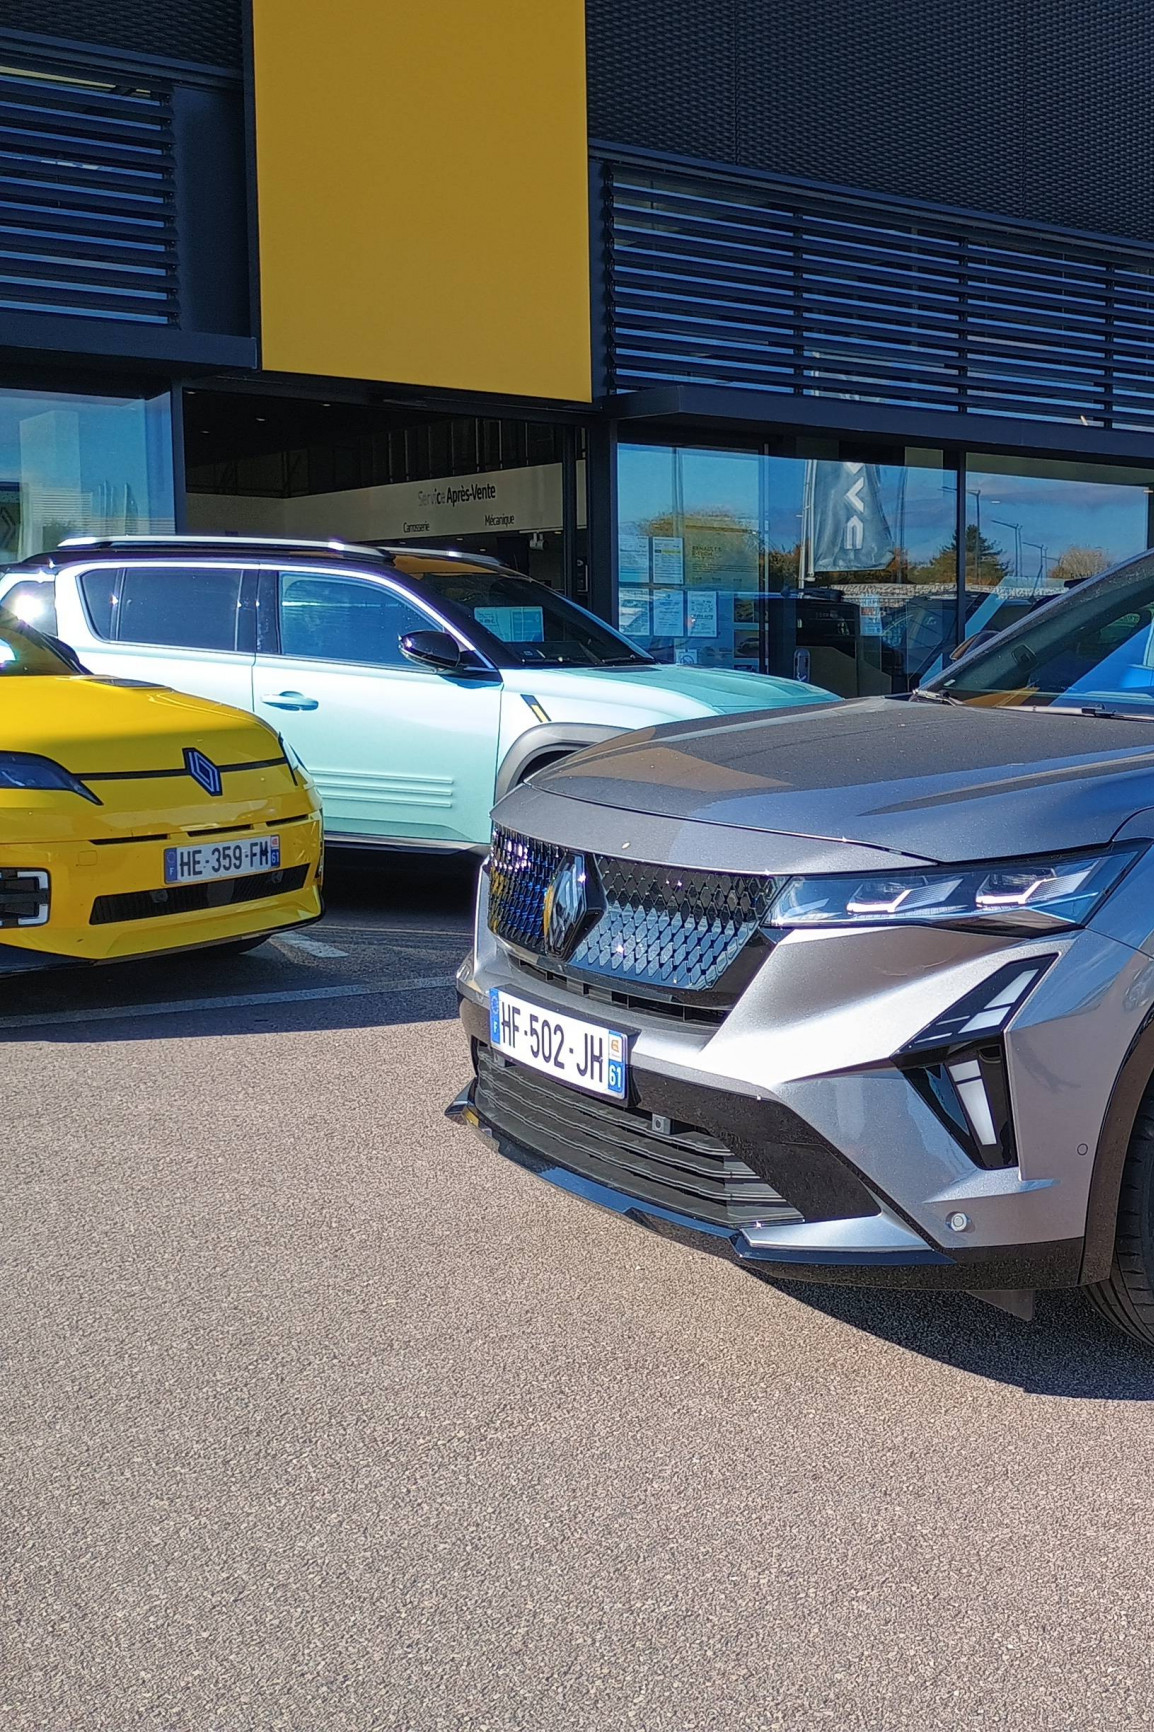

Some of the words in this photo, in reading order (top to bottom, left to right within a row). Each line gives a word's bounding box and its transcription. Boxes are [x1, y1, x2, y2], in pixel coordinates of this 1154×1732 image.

[418, 488, 446, 507] Service
[446, 483, 496, 507] Après-Vente
[485, 514, 514, 529] Mécanique
[180, 840, 269, 877] HE-359-FM
[272, 851, 279, 864] 61
[493, 1021, 498, 1034] F
[501, 1001, 603, 1083] HF-502-JH
[609, 1063, 622, 1089] 61
